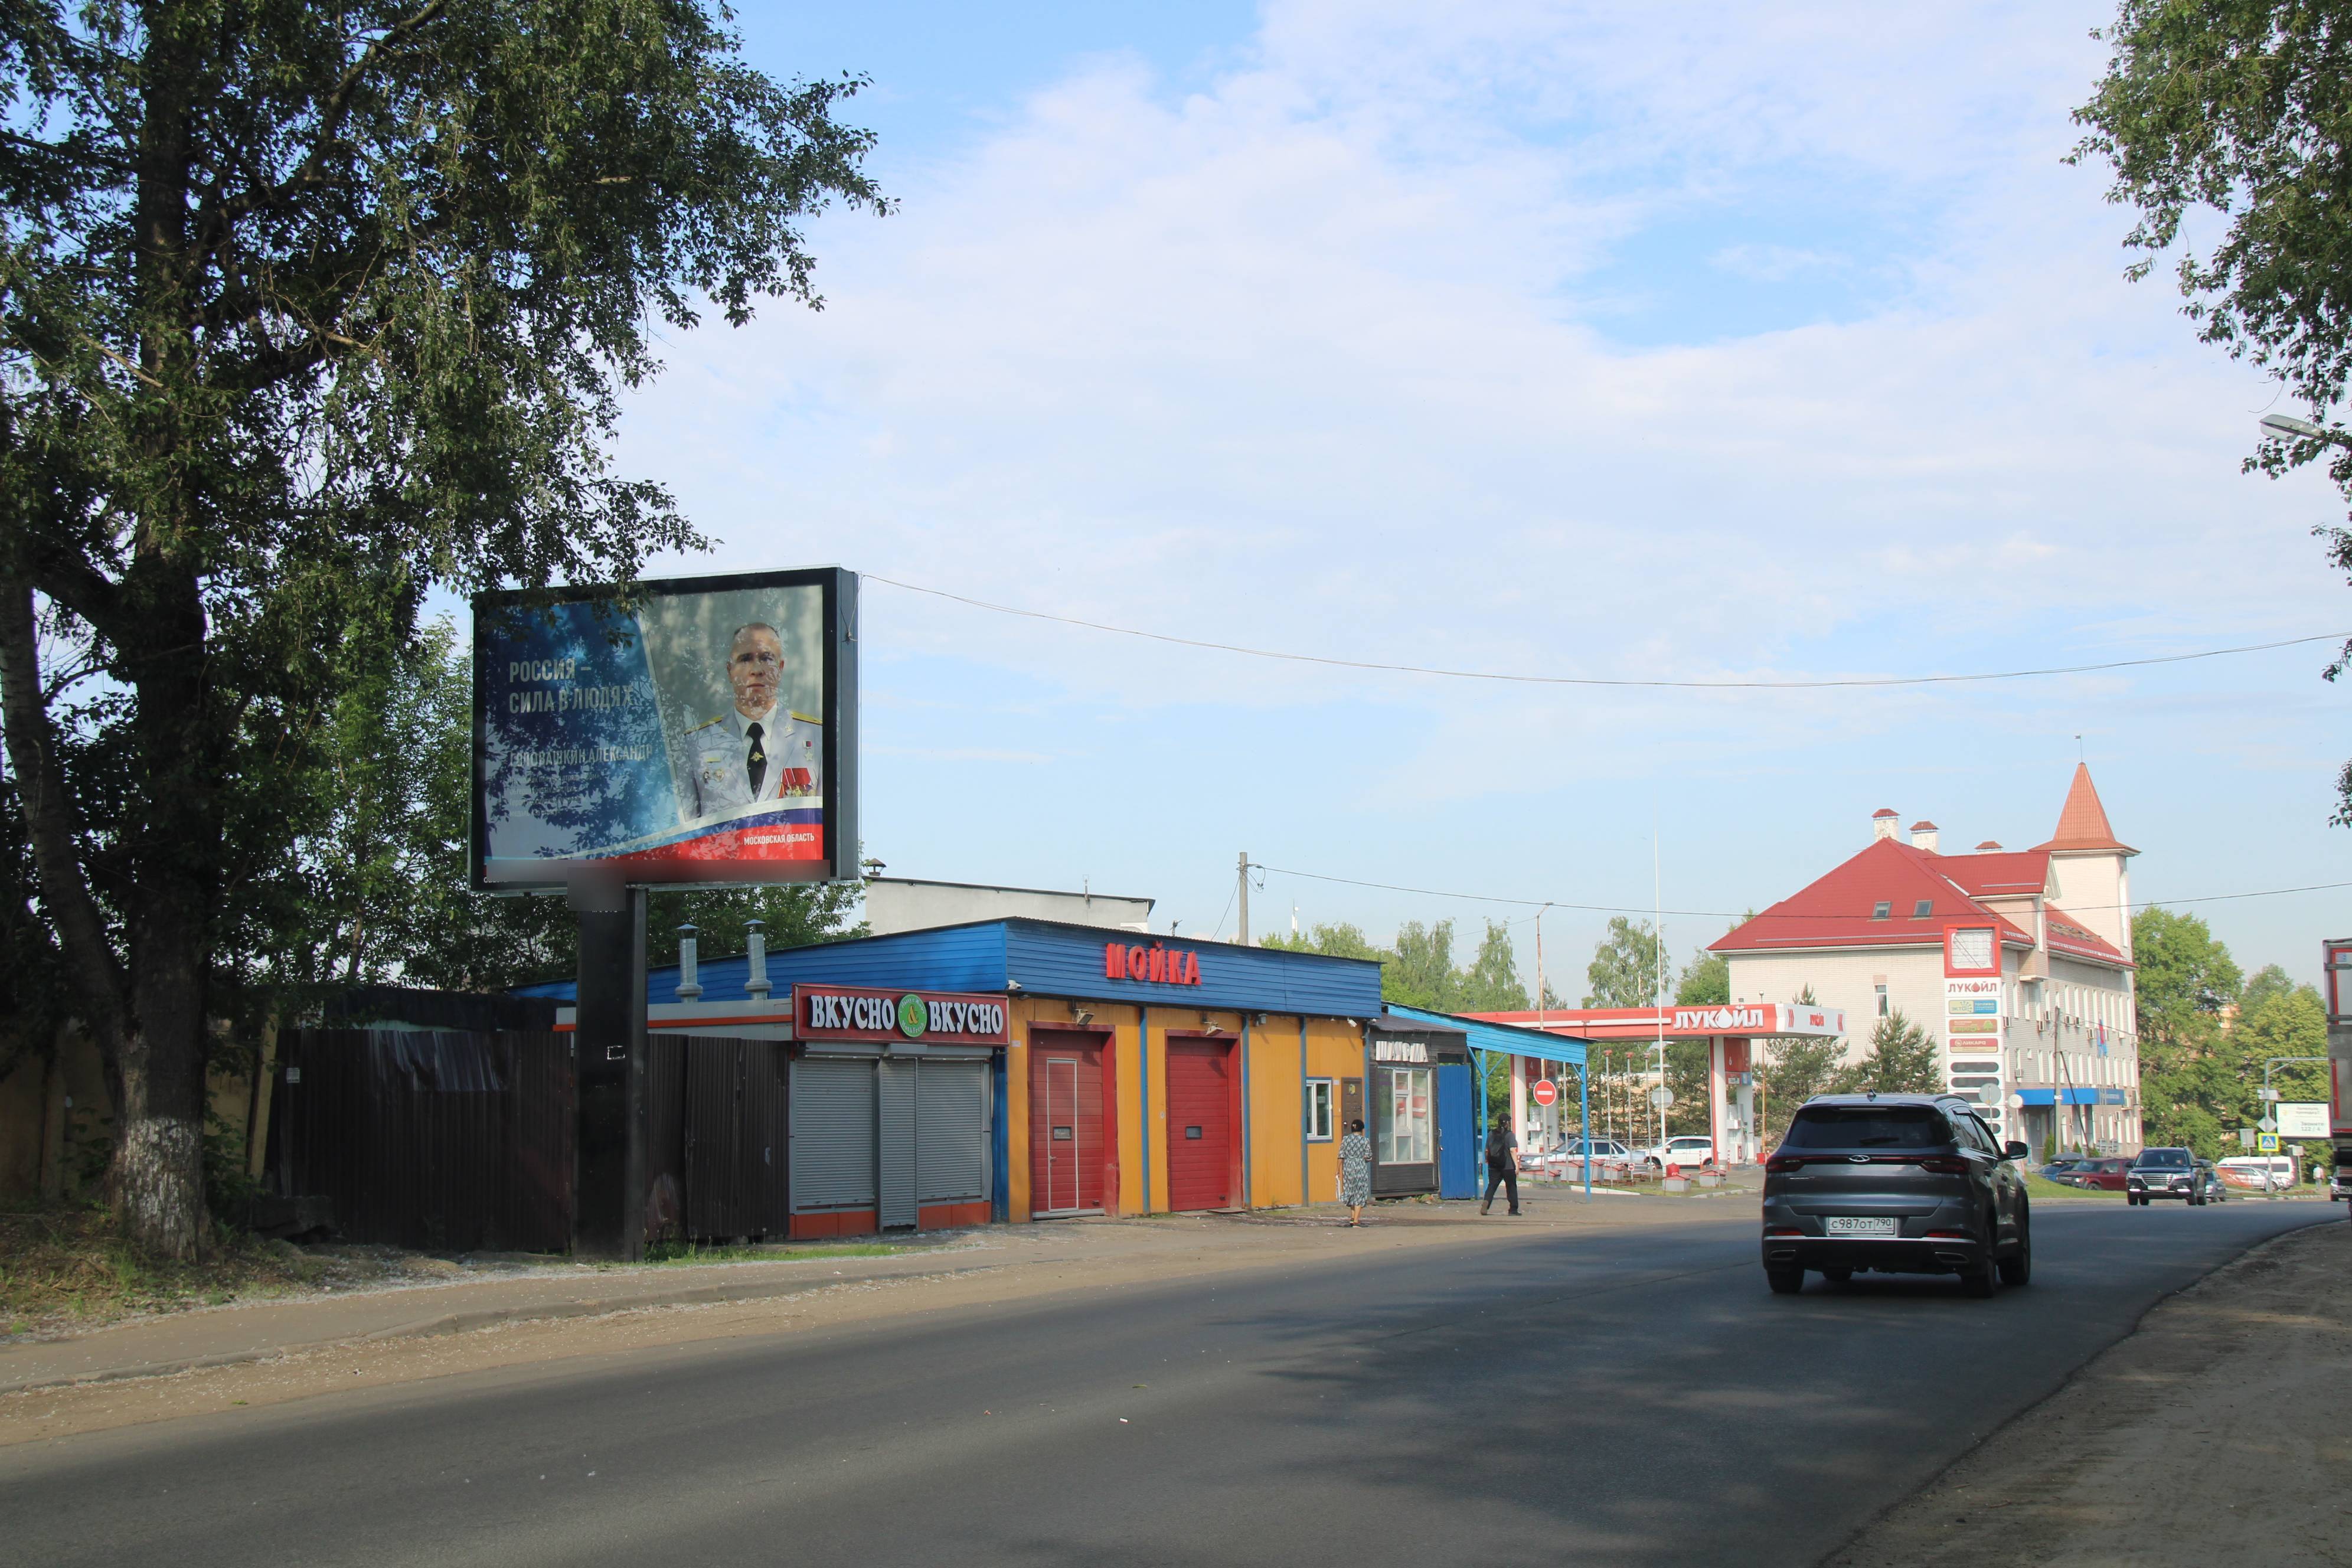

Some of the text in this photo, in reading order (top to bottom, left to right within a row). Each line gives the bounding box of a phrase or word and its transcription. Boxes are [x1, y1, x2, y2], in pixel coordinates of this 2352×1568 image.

[510, 657, 576, 683] РОССИЯ
[509, 684, 633, 714] СИЛА В ЛЮДЯХ
[589, 744, 652, 763] АЛЕКСАНДР
[744, 832, 814, 845] МОСКОВСКАЯ ОБЛАСТЬ
[1106, 940, 1202, 986] МОЙКА
[1948, 981, 1997, 992] ЛУКОЙЛ
[811, 995, 895, 1030] ВКУСНО
[929, 1001, 1004, 1034] ВКУСНО
[1673, 1005, 1763, 1030] ЛУКОЙЛ
[1376, 1040, 1429, 1063] ШАУРМА
